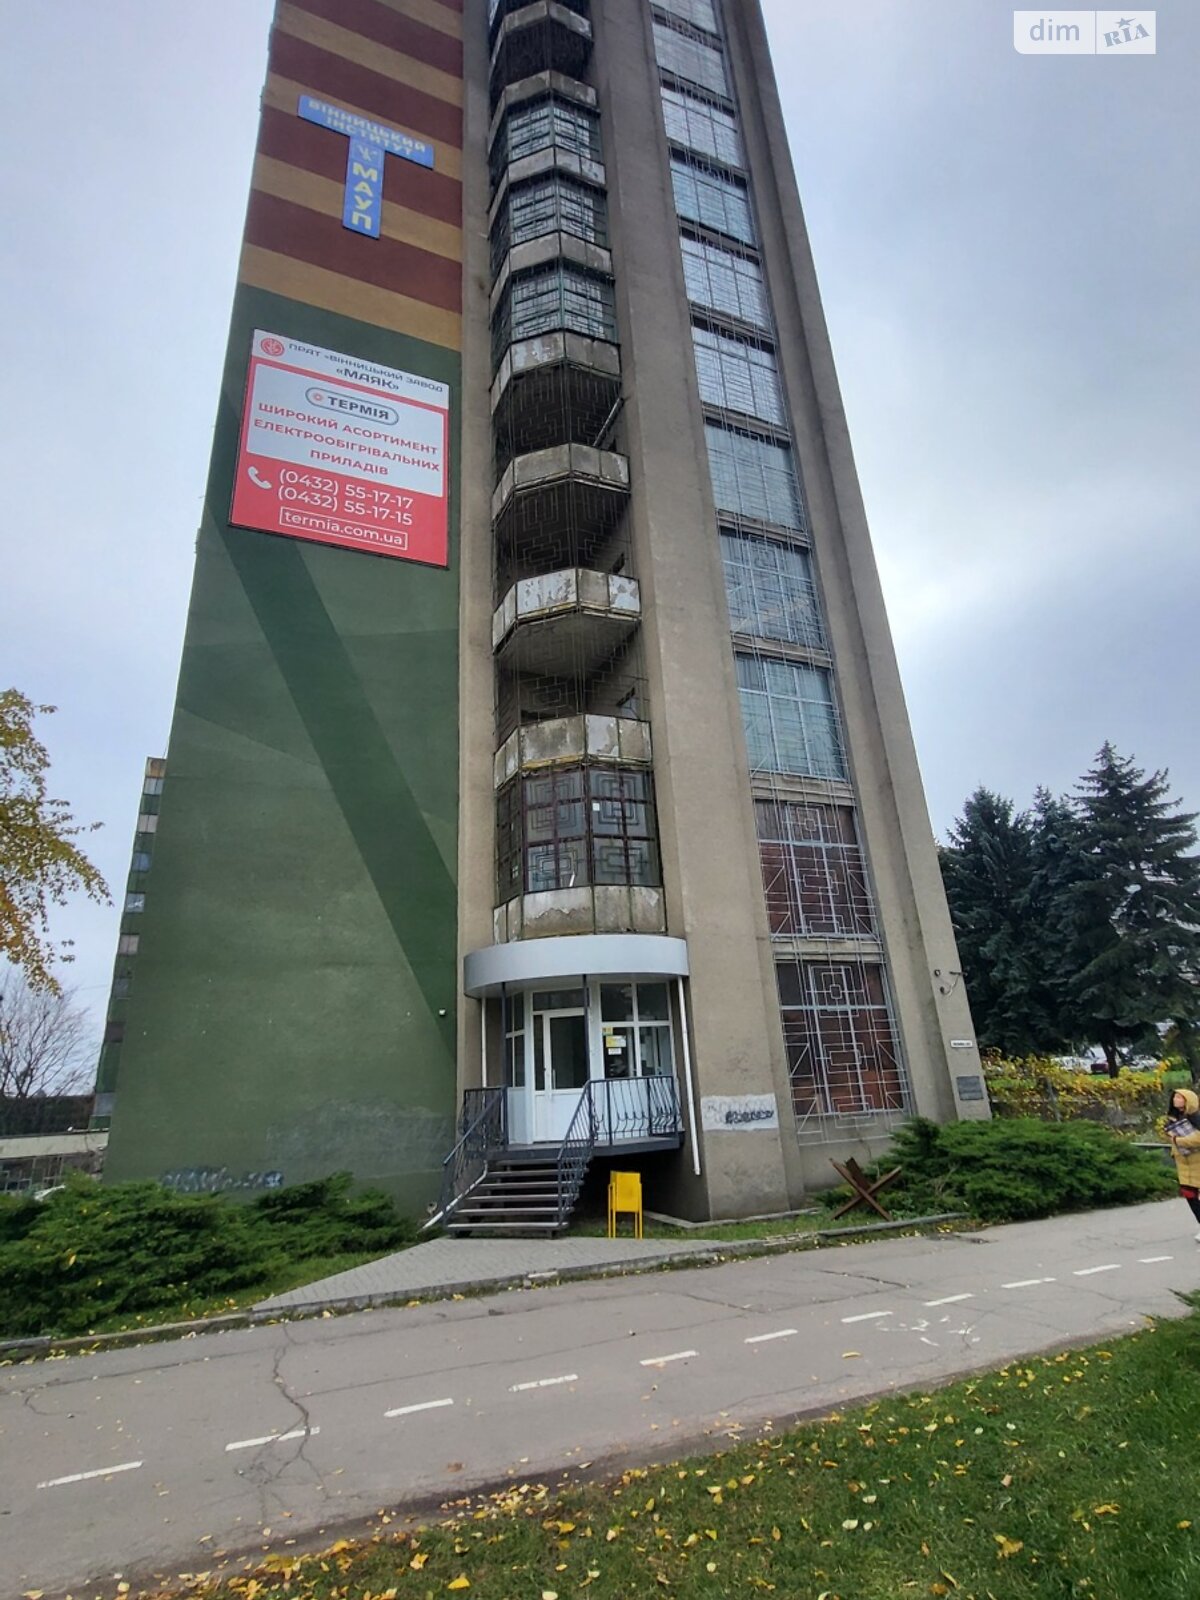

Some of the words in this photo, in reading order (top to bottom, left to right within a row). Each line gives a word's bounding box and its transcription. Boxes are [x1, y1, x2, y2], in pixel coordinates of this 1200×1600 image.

[327, 117, 413, 155] ІНСТИТУТ
[351, 162, 378, 230] МАУП
[336, 368, 399, 390] «МАЯК»
[406, 377, 443, 392] ЗАВОД
[327, 396, 389, 420] ТЕРМІЯ
[254, 418, 440, 471] ЕЛЕКТРООБІГРІВАЛЬНИХ
[258, 402, 338, 429] ШИРОКИЙ
[342, 424, 438, 455] АСОРТИМЕНТ
[310, 449, 389, 475] ПРИЛАДІВ
[278, 485, 338, 512] (0432)
[344, 500, 413, 526] 55-17-15
[280, 468, 338, 496] (0432)
[344, 484, 414, 509] 55-17-17
[284, 511, 403, 545] termia.com.ua
